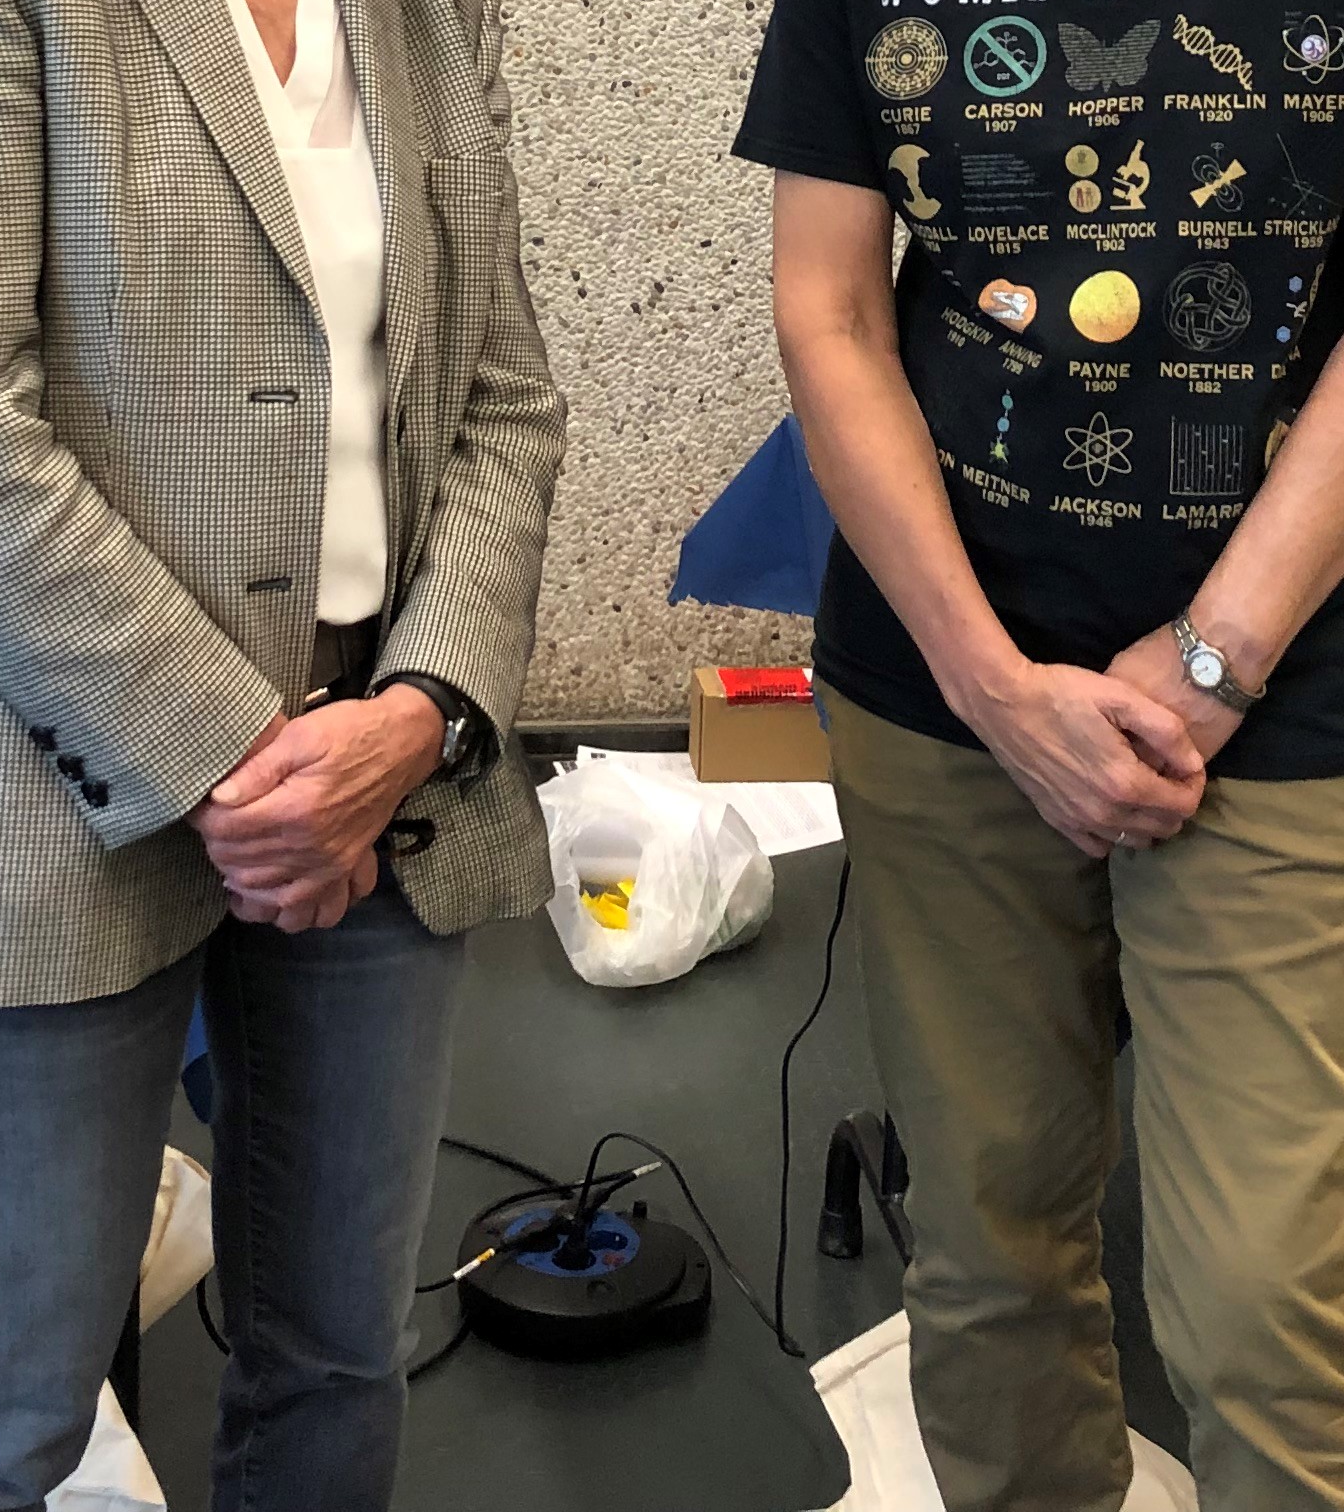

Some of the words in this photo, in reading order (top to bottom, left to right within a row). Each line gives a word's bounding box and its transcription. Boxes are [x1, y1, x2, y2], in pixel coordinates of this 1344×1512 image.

[880, 106, 932, 123] CURIE
[964, 102, 1043, 120] CARSON
[1067, 95, 1144, 117] HOPPER
[1163, 93, 1267, 111] FRANKLIN
[984, 120, 1018, 133] 1907
[1087, 114, 1120, 128] 1906
[1199, 109, 1234, 123] 1920
[1302, 109, 1335, 123] 1906
[968, 224, 1050, 242] LOVELACE
[1066, 221, 1157, 240] MCCLINTOCK
[1178, 220, 1258, 237] BURNELL
[989, 242, 1022, 255] 1815
[1095, 238, 1126, 252] 1902
[1197, 237, 1230, 250] 1943
[1294, 236, 1324, 249] 1959
[941, 306, 994, 345] HODGKIN
[998, 339, 1043, 369] ANNING
[1068, 361, 1131, 379] PAYNE
[1159, 361, 1256, 380] NOETHER
[1084, 380, 1118, 393] 1900
[1188, 380, 1222, 394] 1882
[962, 464, 1030, 505] MEITNER
[1049, 495, 1142, 519] JACKSON
[1079, 513, 1113, 528] 1946
